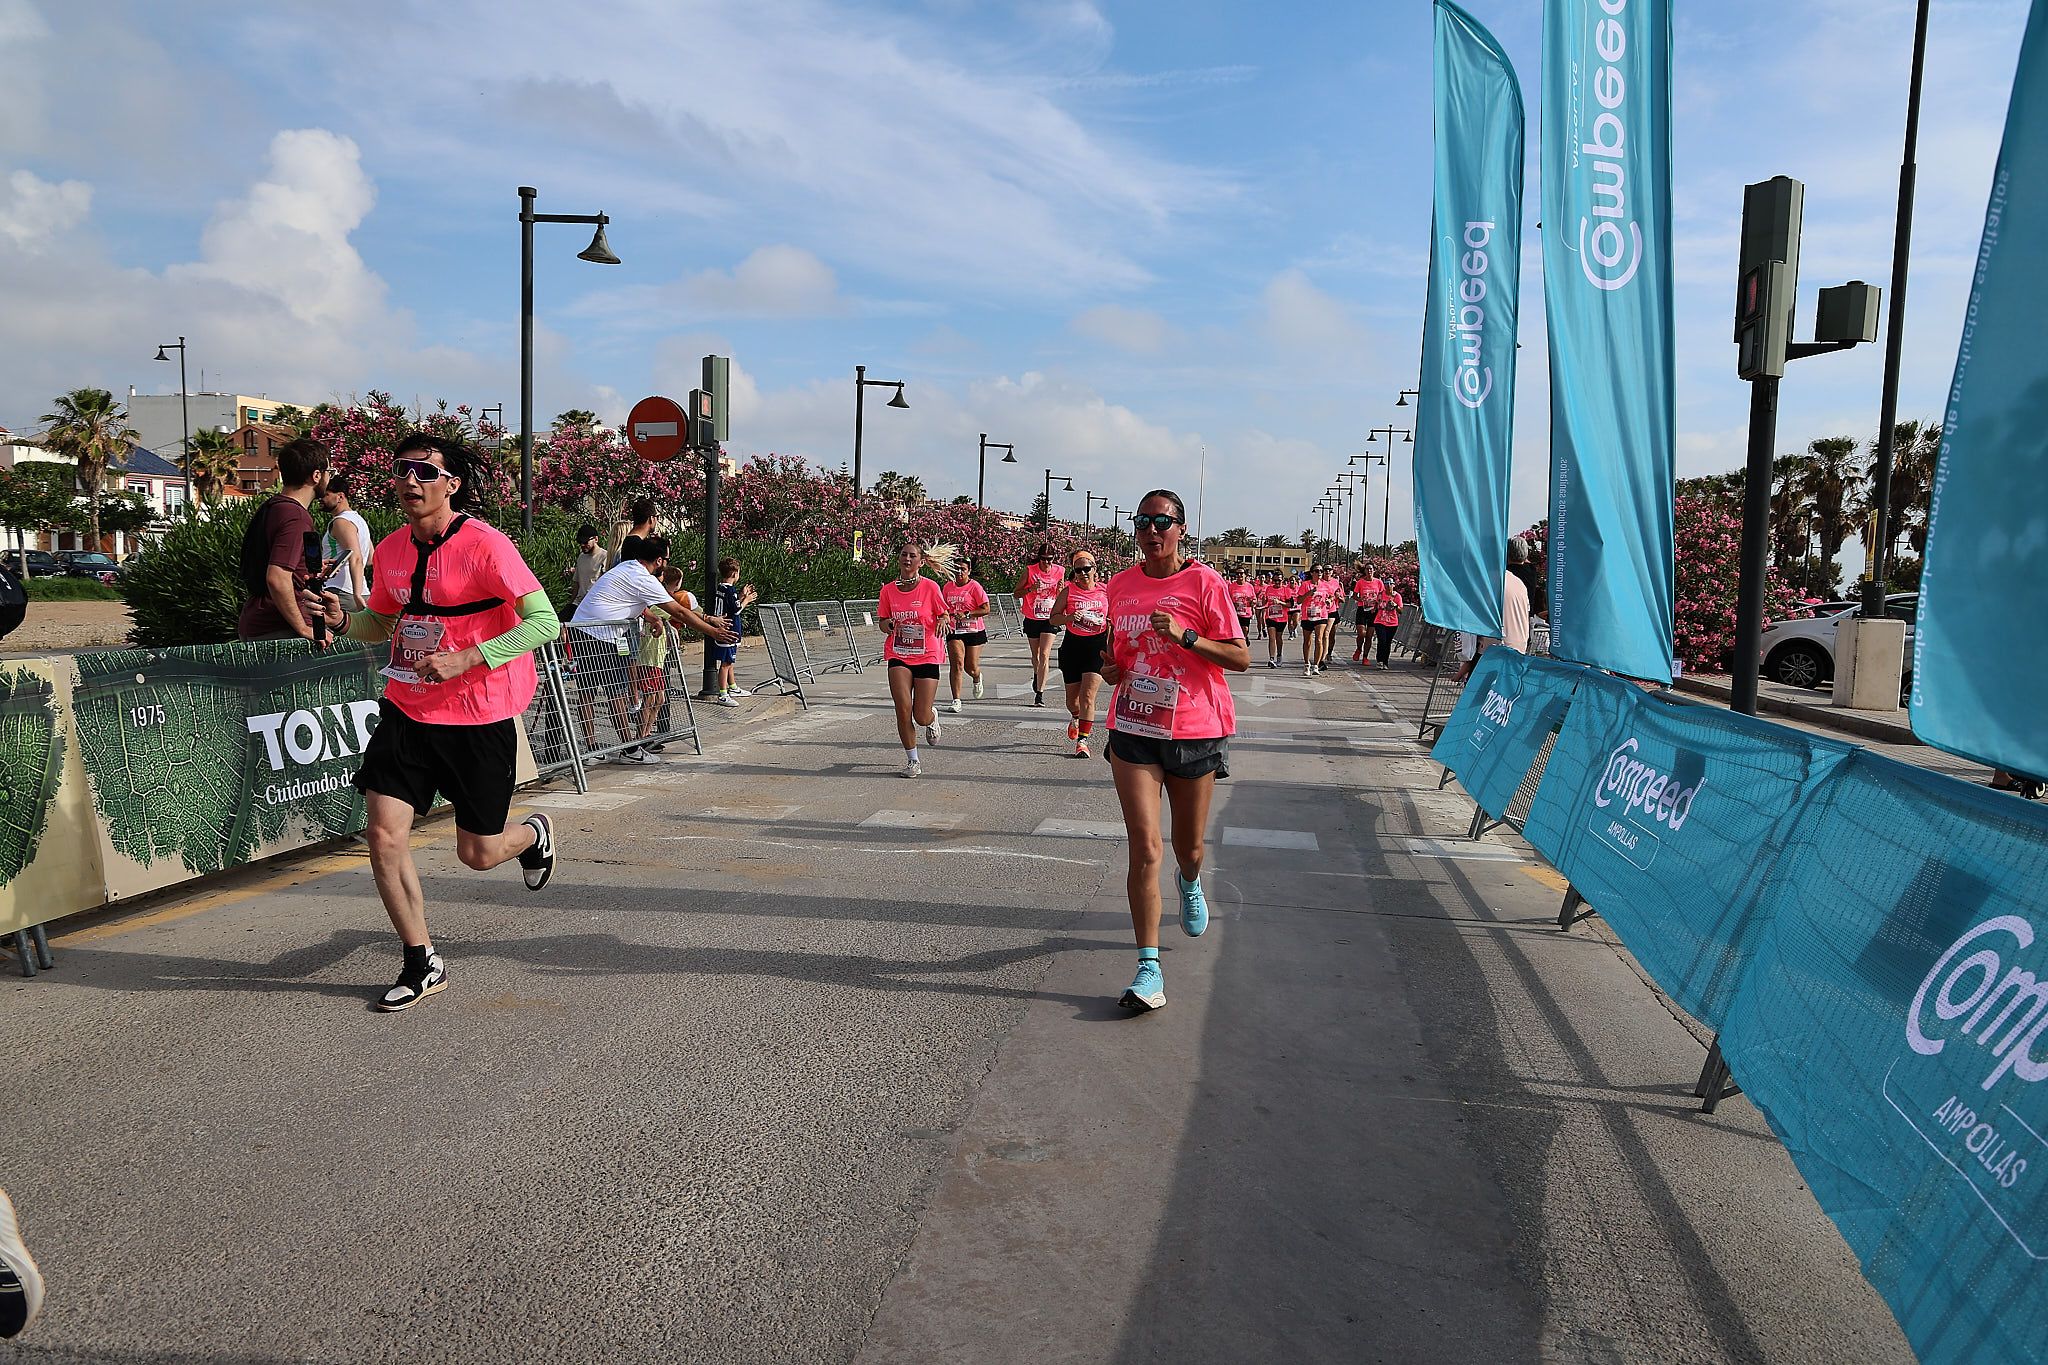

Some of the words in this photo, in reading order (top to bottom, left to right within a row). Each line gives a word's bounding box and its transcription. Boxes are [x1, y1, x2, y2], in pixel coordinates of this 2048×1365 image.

[1074, 600, 1103, 609] CARRERA
[129, 704, 166, 728] 1975
[1129, 700, 1154, 715] 016
[265, 771, 339, 805] Cuidando
[1595, 737, 1706, 831] Compeed
[1606, 820, 1639, 851] AMPOLLAS
[1932, 1095, 2028, 1189] AMPOLLAS
